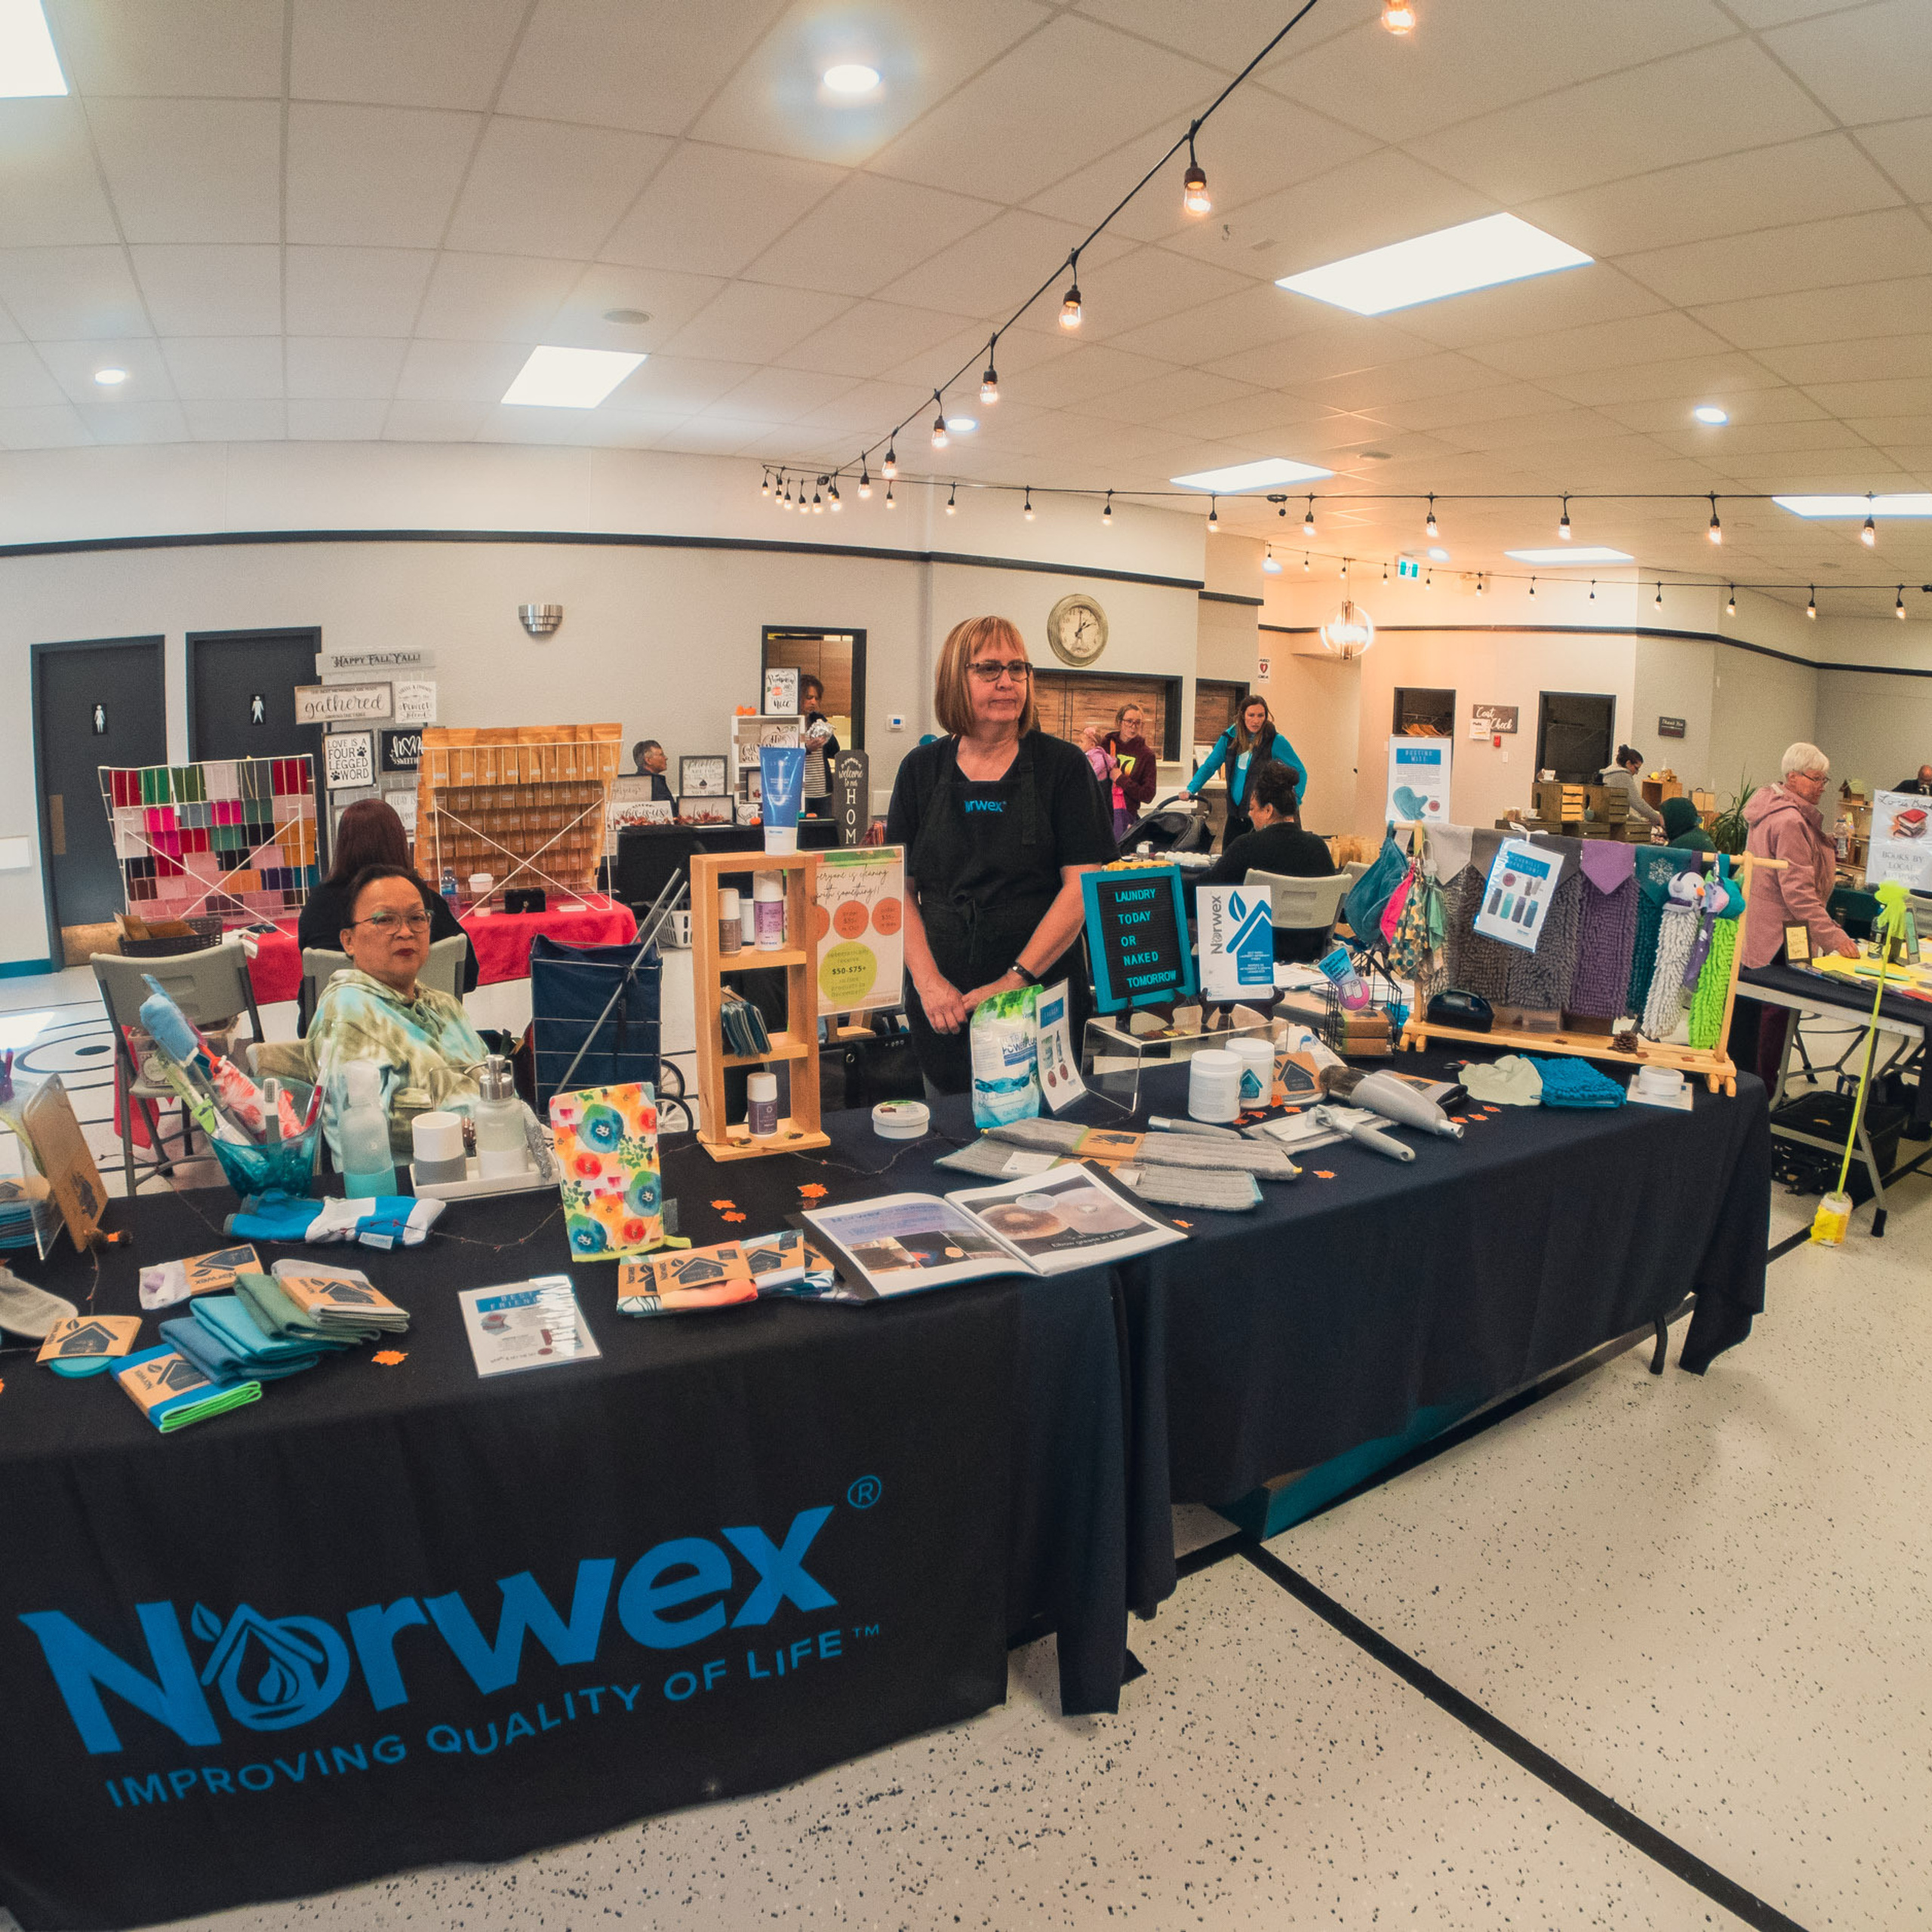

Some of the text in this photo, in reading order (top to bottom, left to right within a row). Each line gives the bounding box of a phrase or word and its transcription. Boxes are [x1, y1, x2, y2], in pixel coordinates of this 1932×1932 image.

[331, 654, 365, 669] HAPPY
[366, 653, 391, 666] FALL
[305, 694, 383, 719] gathered
[1476, 706, 1495, 718] Coat
[1491, 718, 1512, 730] Check
[328, 737, 368, 749] LOVE IS A
[328, 748, 355, 760] FOUR
[329, 758, 369, 771] LEGGED
[340, 768, 370, 781] WORD
[838, 766, 863, 779] welcome
[964, 800, 1003, 813] rwex
[845, 788, 857, 844] HOM
[1882, 851, 1924, 863] BOOKS BY
[1888, 861, 1915, 872] LOCAL
[817, 871, 845, 889] veryone
[1115, 888, 1156, 903] LAUNDRY
[1118, 911, 1151, 925] TODAY
[1211, 895, 1223, 955] Norwex
[1121, 935, 1137, 948] OR
[1123, 951, 1159, 967] NAKED
[832, 965, 866, 975] $50-$75+
[1127, 970, 1177, 989] TOMORROW
[501, 1291, 534, 1302] BEST
[106, 1734, 407, 1808] IMPROVING
[426, 1684, 641, 1755] QUALITY
[663, 1659, 727, 1702] OF
